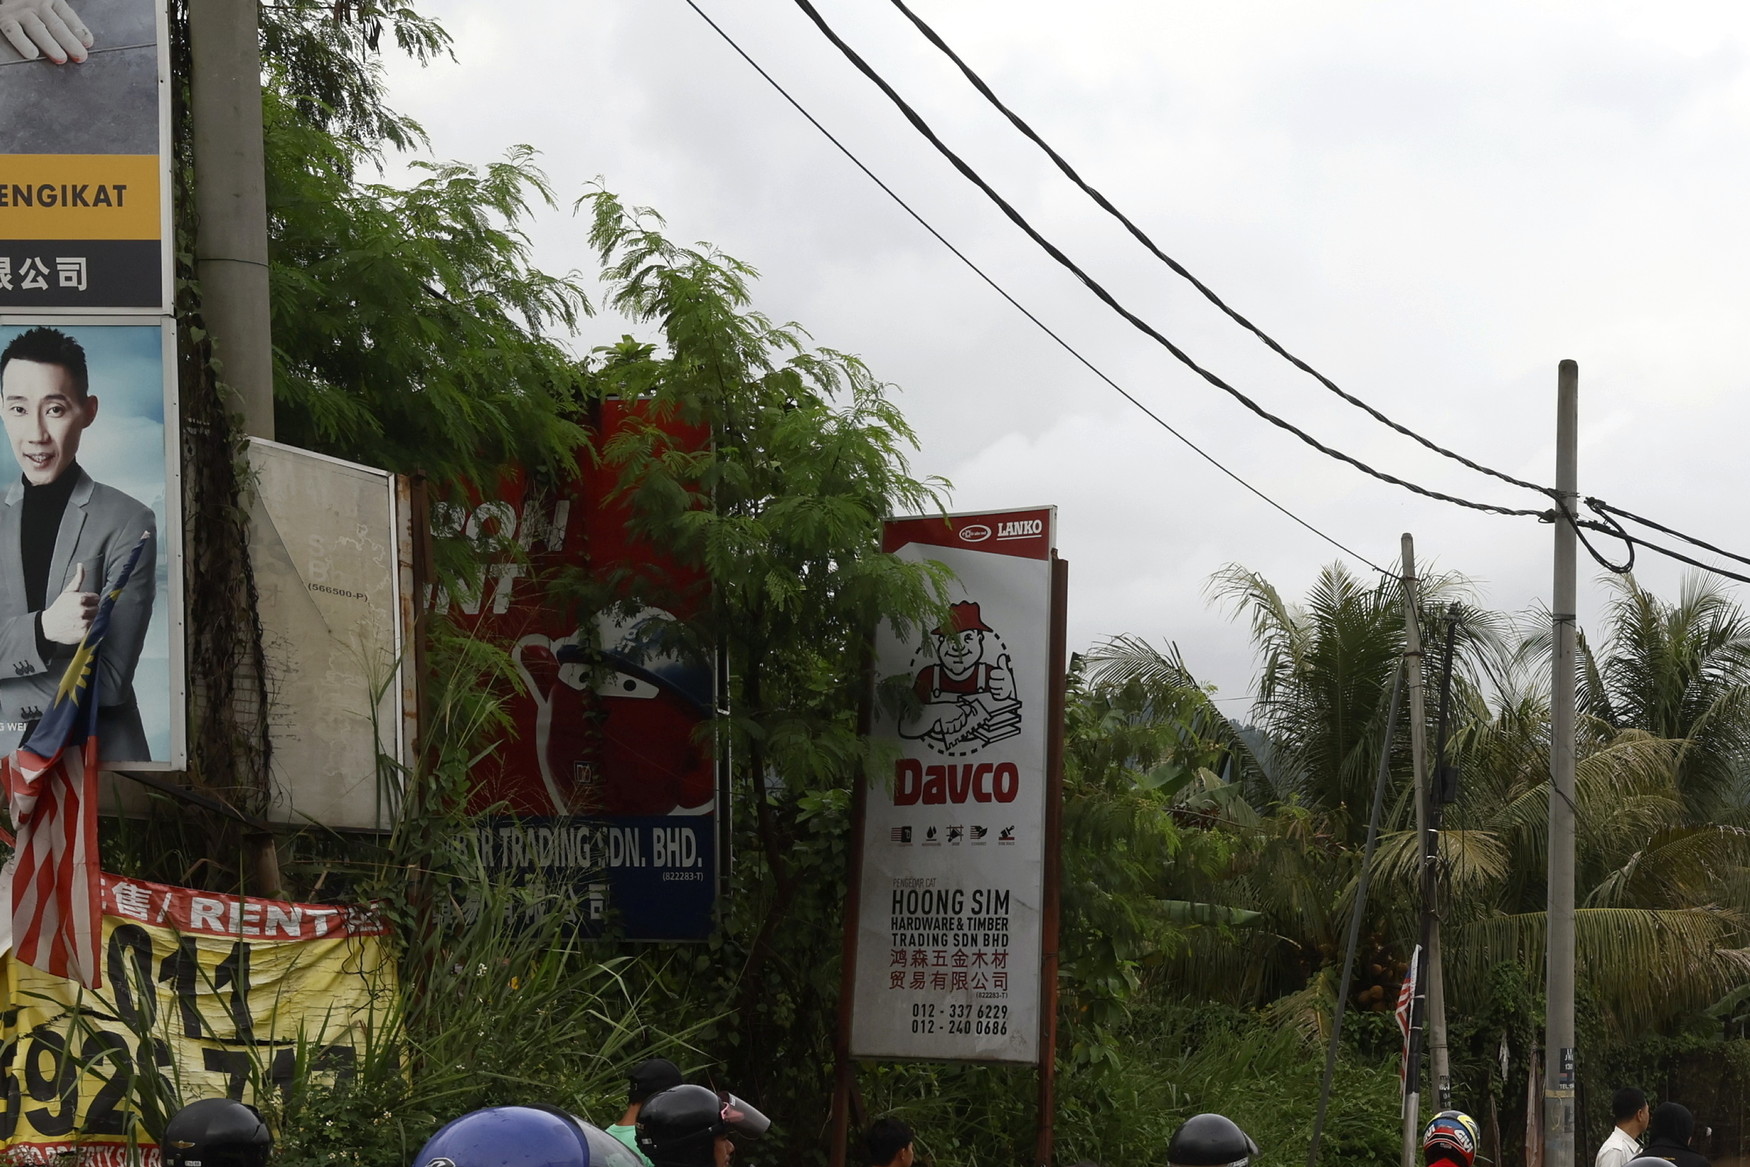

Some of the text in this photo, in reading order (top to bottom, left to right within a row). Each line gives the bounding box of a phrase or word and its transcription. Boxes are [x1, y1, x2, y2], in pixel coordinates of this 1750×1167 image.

[997, 519, 1043, 537] LANKO
[308, 582, 369, 602] (566500-P)
[7, 722, 27, 732] WEI
[893, 758, 1019, 806] Davco
[499, 827, 590, 868] TRADING
[653, 827, 703, 868] BHD.
[662, 872, 704, 882] (822283-T)
[926, 878, 936, 888] CAT
[892, 889, 1010, 915] HOONG SIM
[190, 896, 338, 938] RENT
[891, 917, 1009, 931] HARDWARE & TIMBER
[892, 933, 1009, 947] TRADING SDN BHD
[889, 948, 1009, 969] 鸿森五金木材
[107, 924, 253, 1040] 011
[889, 970, 1008, 992] 贸易有限公司
[912, 1003, 935, 1018] 012
[949, 1003, 972, 1018] 337
[977, 1004, 1008, 1019] 6229
[912, 1019, 935, 1033] 012
[949, 1020, 971, 1034] 240
[976, 1020, 1007, 1035] 0686
